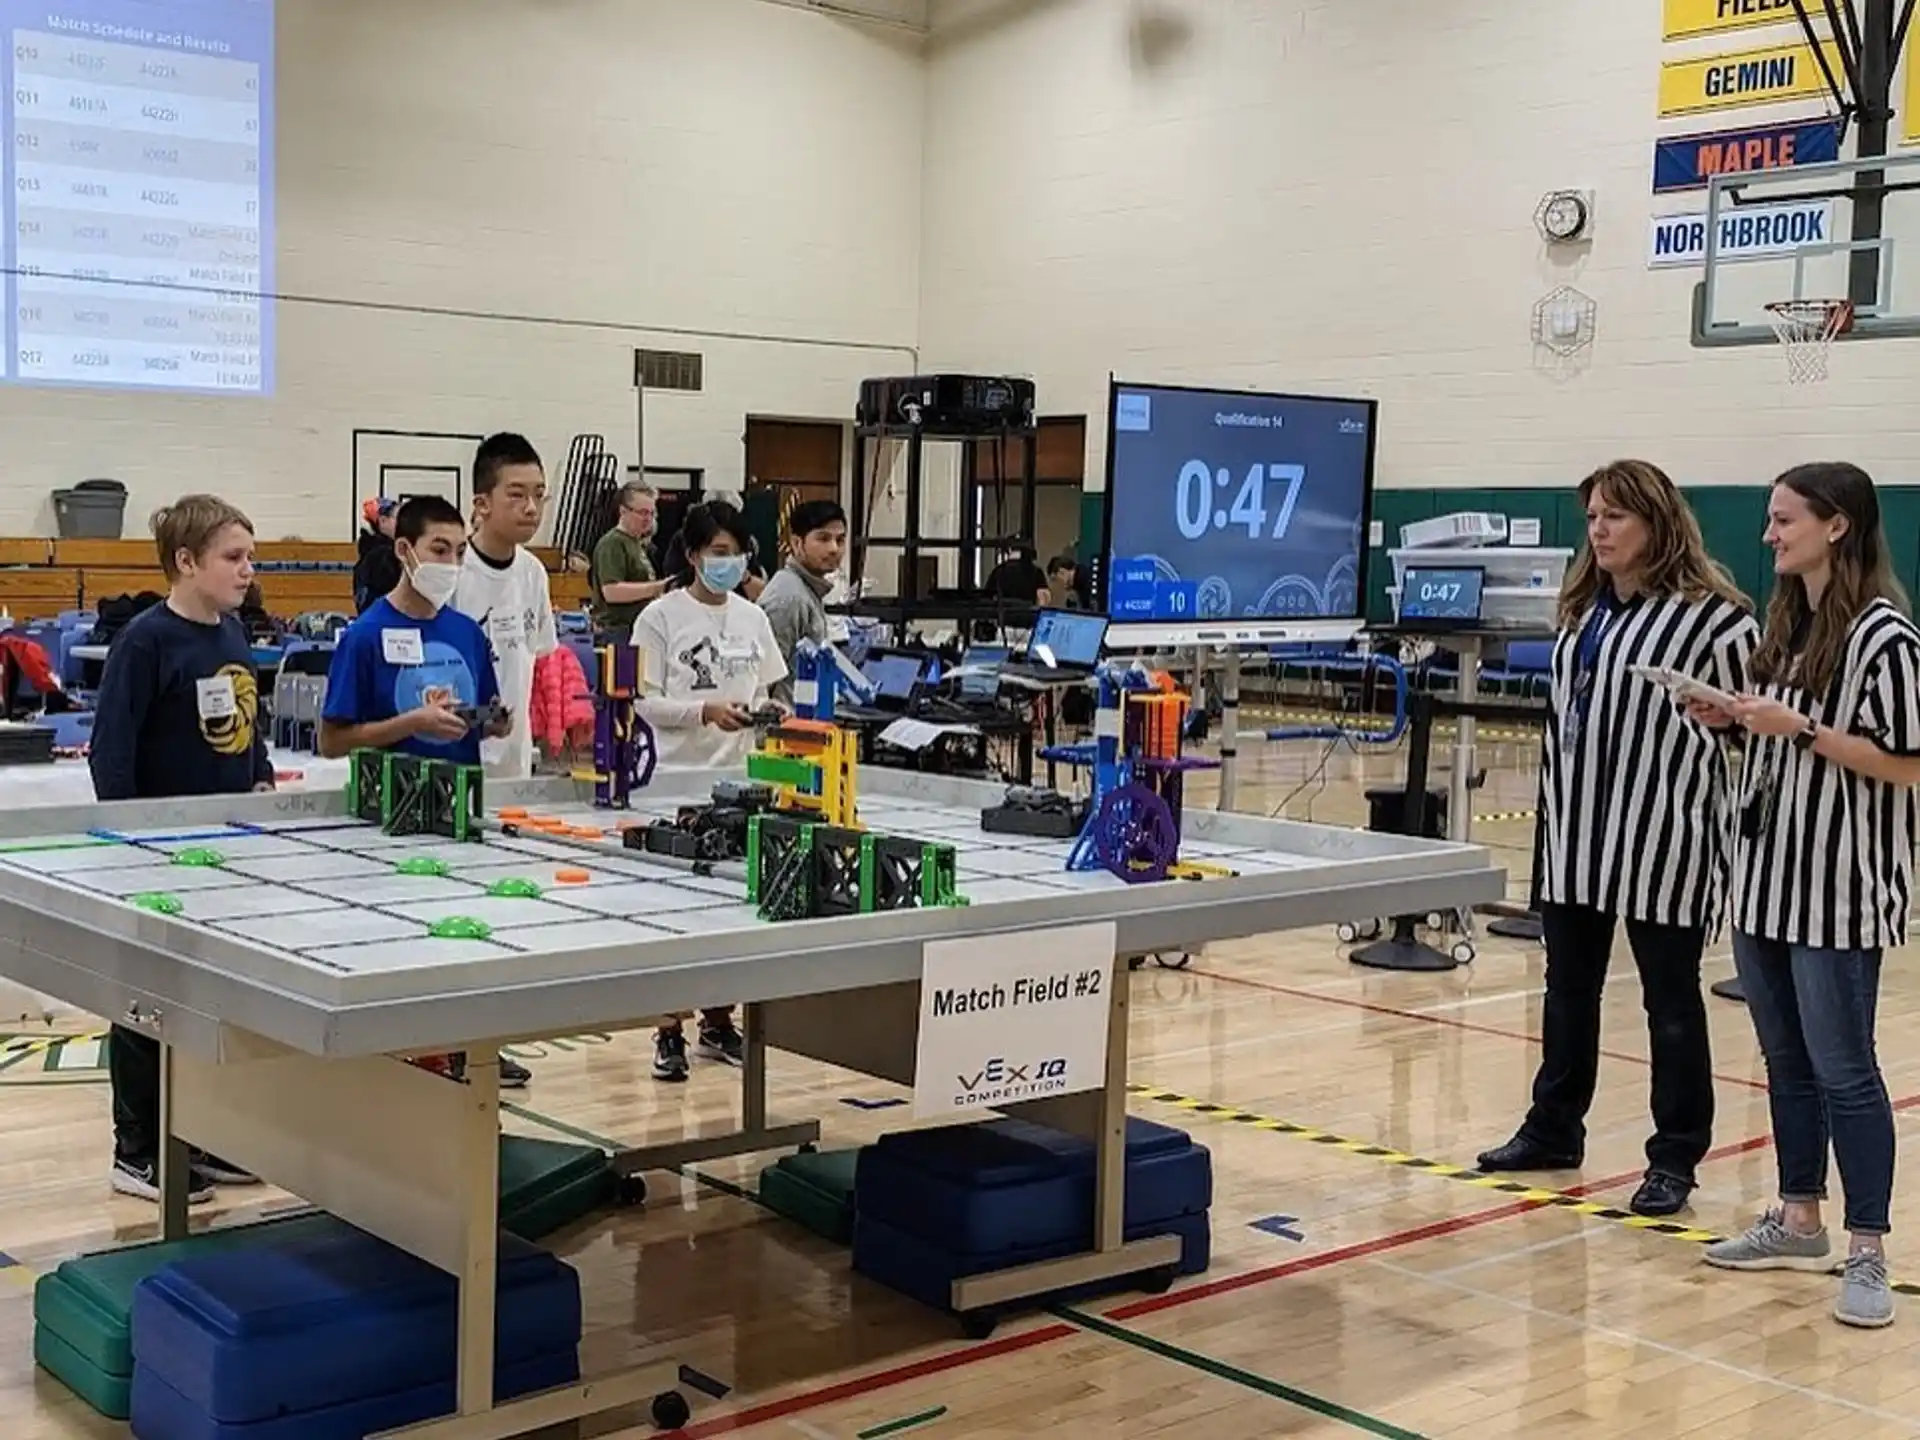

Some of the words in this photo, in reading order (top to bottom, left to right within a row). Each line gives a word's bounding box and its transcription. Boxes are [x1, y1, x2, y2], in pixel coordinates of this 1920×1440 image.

[47, 14, 90, 32] Match
[92, 21, 153, 42] Schedule
[155, 29, 182, 46] and
[183, 35, 231, 54] Results
[1705, 55, 1795, 97] GEMINI
[1698, 134, 1796, 176] MAPLE
[1655, 209, 1824, 254] NORHBROOK
[1214, 412, 1271, 428] Qualification
[1272, 415, 1283, 429] 14
[1176, 459, 1305, 539] 0:47
[1169, 591, 1186, 613] 10
[1420, 583, 1461, 602] 0:47
[933, 983, 1005, 1018] Match
[1013, 973, 1069, 1006] Field
[1074, 968, 1101, 997] #2
[954, 1078, 1066, 1106] COMPETITION
[957, 1058, 1029, 1092] VEX
[1035, 1058, 1067, 1080] IQ
